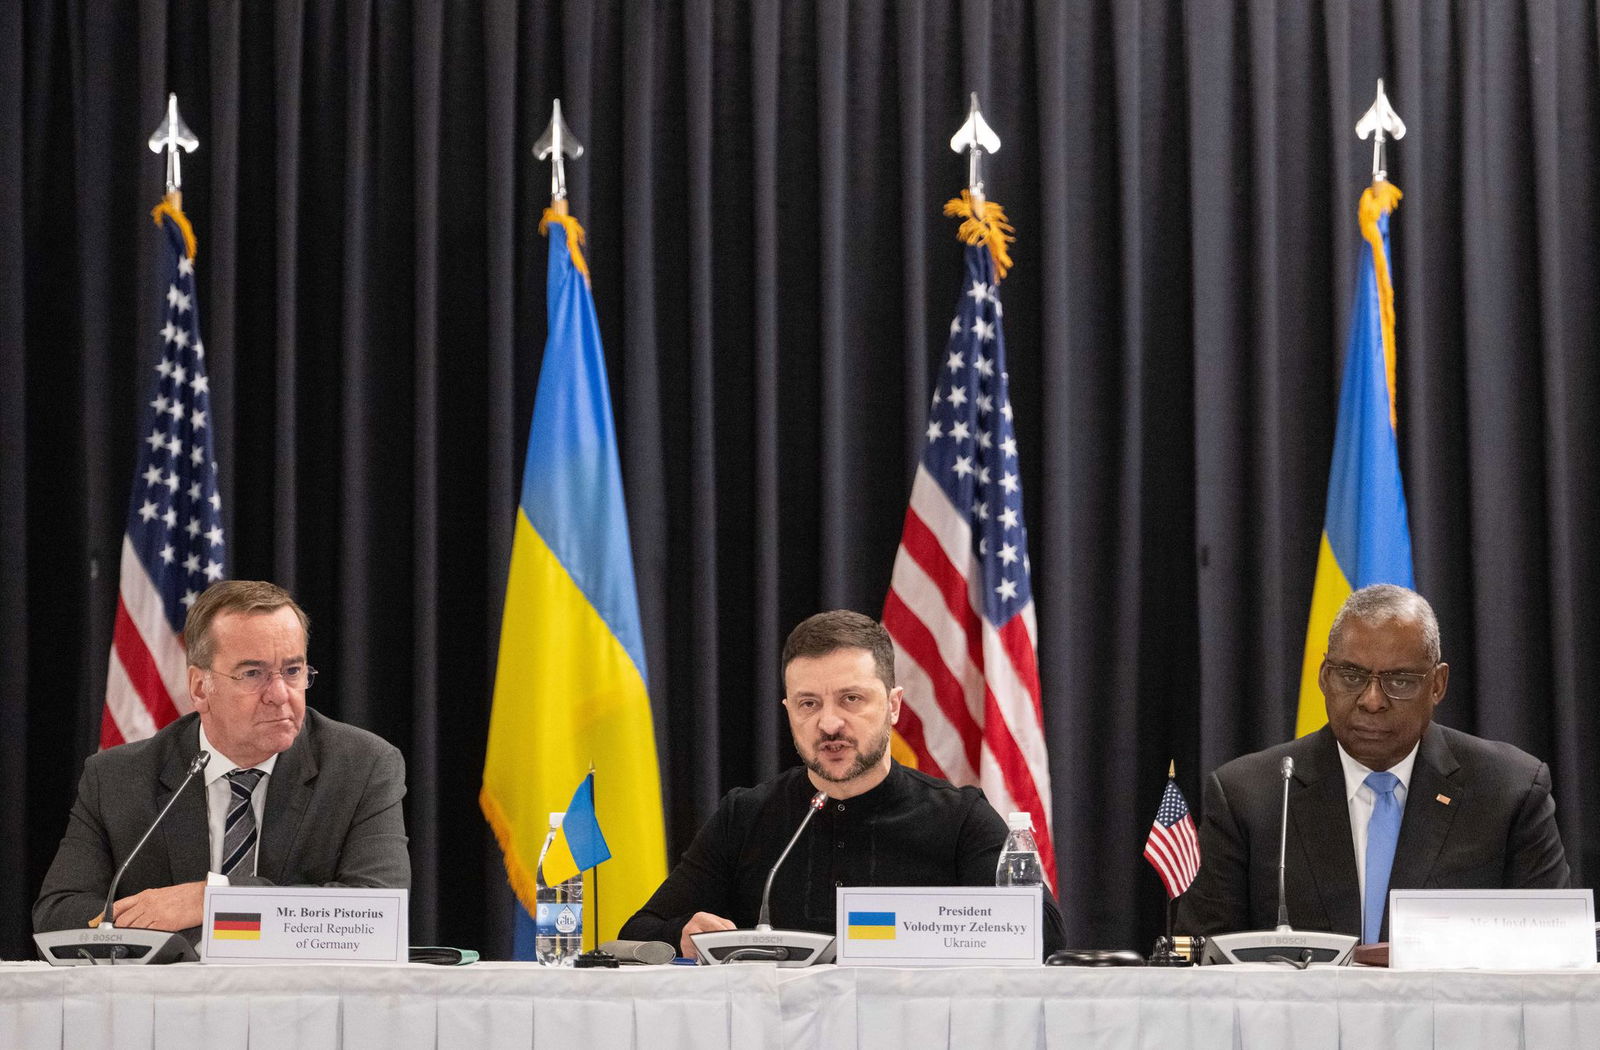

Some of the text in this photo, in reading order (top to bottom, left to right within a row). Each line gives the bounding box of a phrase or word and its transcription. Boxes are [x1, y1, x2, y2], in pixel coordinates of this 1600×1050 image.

[276, 907, 384, 919] Mr. Boris Pistorius
[938, 906, 992, 917] President
[283, 922, 375, 937] Federal Republic
[903, 922, 1027, 935] Volodymyr Zelenskyy
[92, 934, 123, 942] BOSCH
[752, 936, 783, 944] BOSCH
[943, 937, 987, 948] Ukraine
[1275, 936, 1306, 945] BOSCH
[295, 938, 360, 952] of Germany
